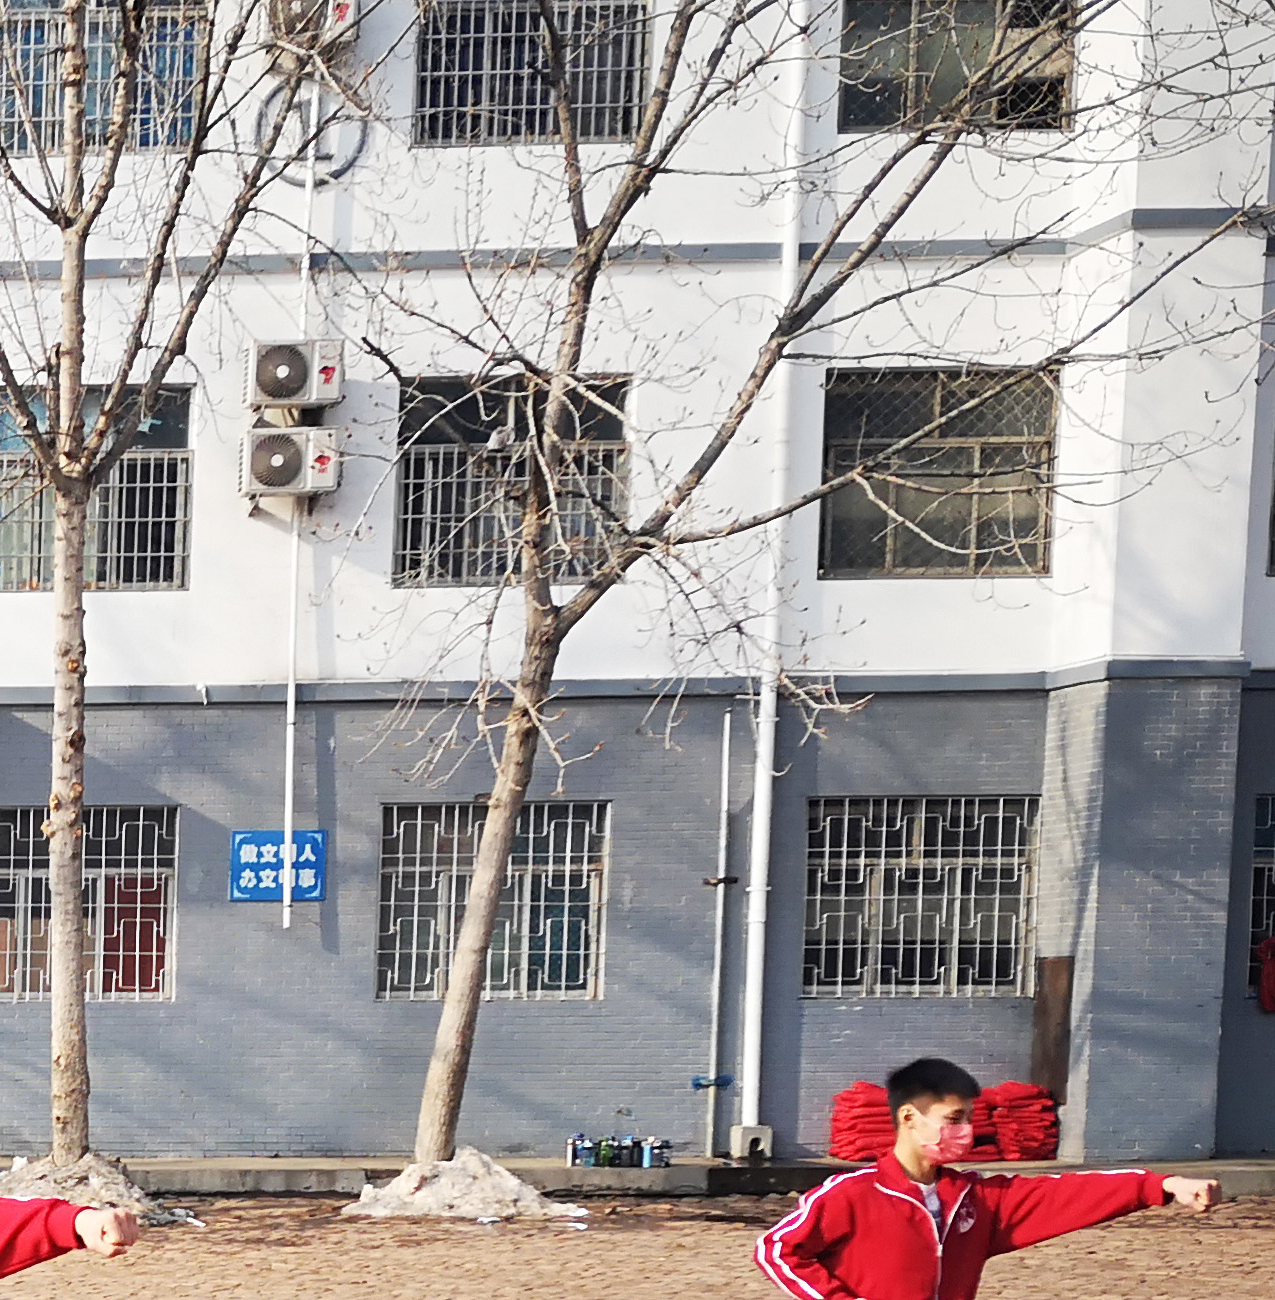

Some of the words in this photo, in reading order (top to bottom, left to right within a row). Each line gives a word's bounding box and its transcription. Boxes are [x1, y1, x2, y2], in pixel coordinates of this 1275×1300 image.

[239, 843, 317, 864] 做文明人
[239, 867, 316, 888] 办文明事
